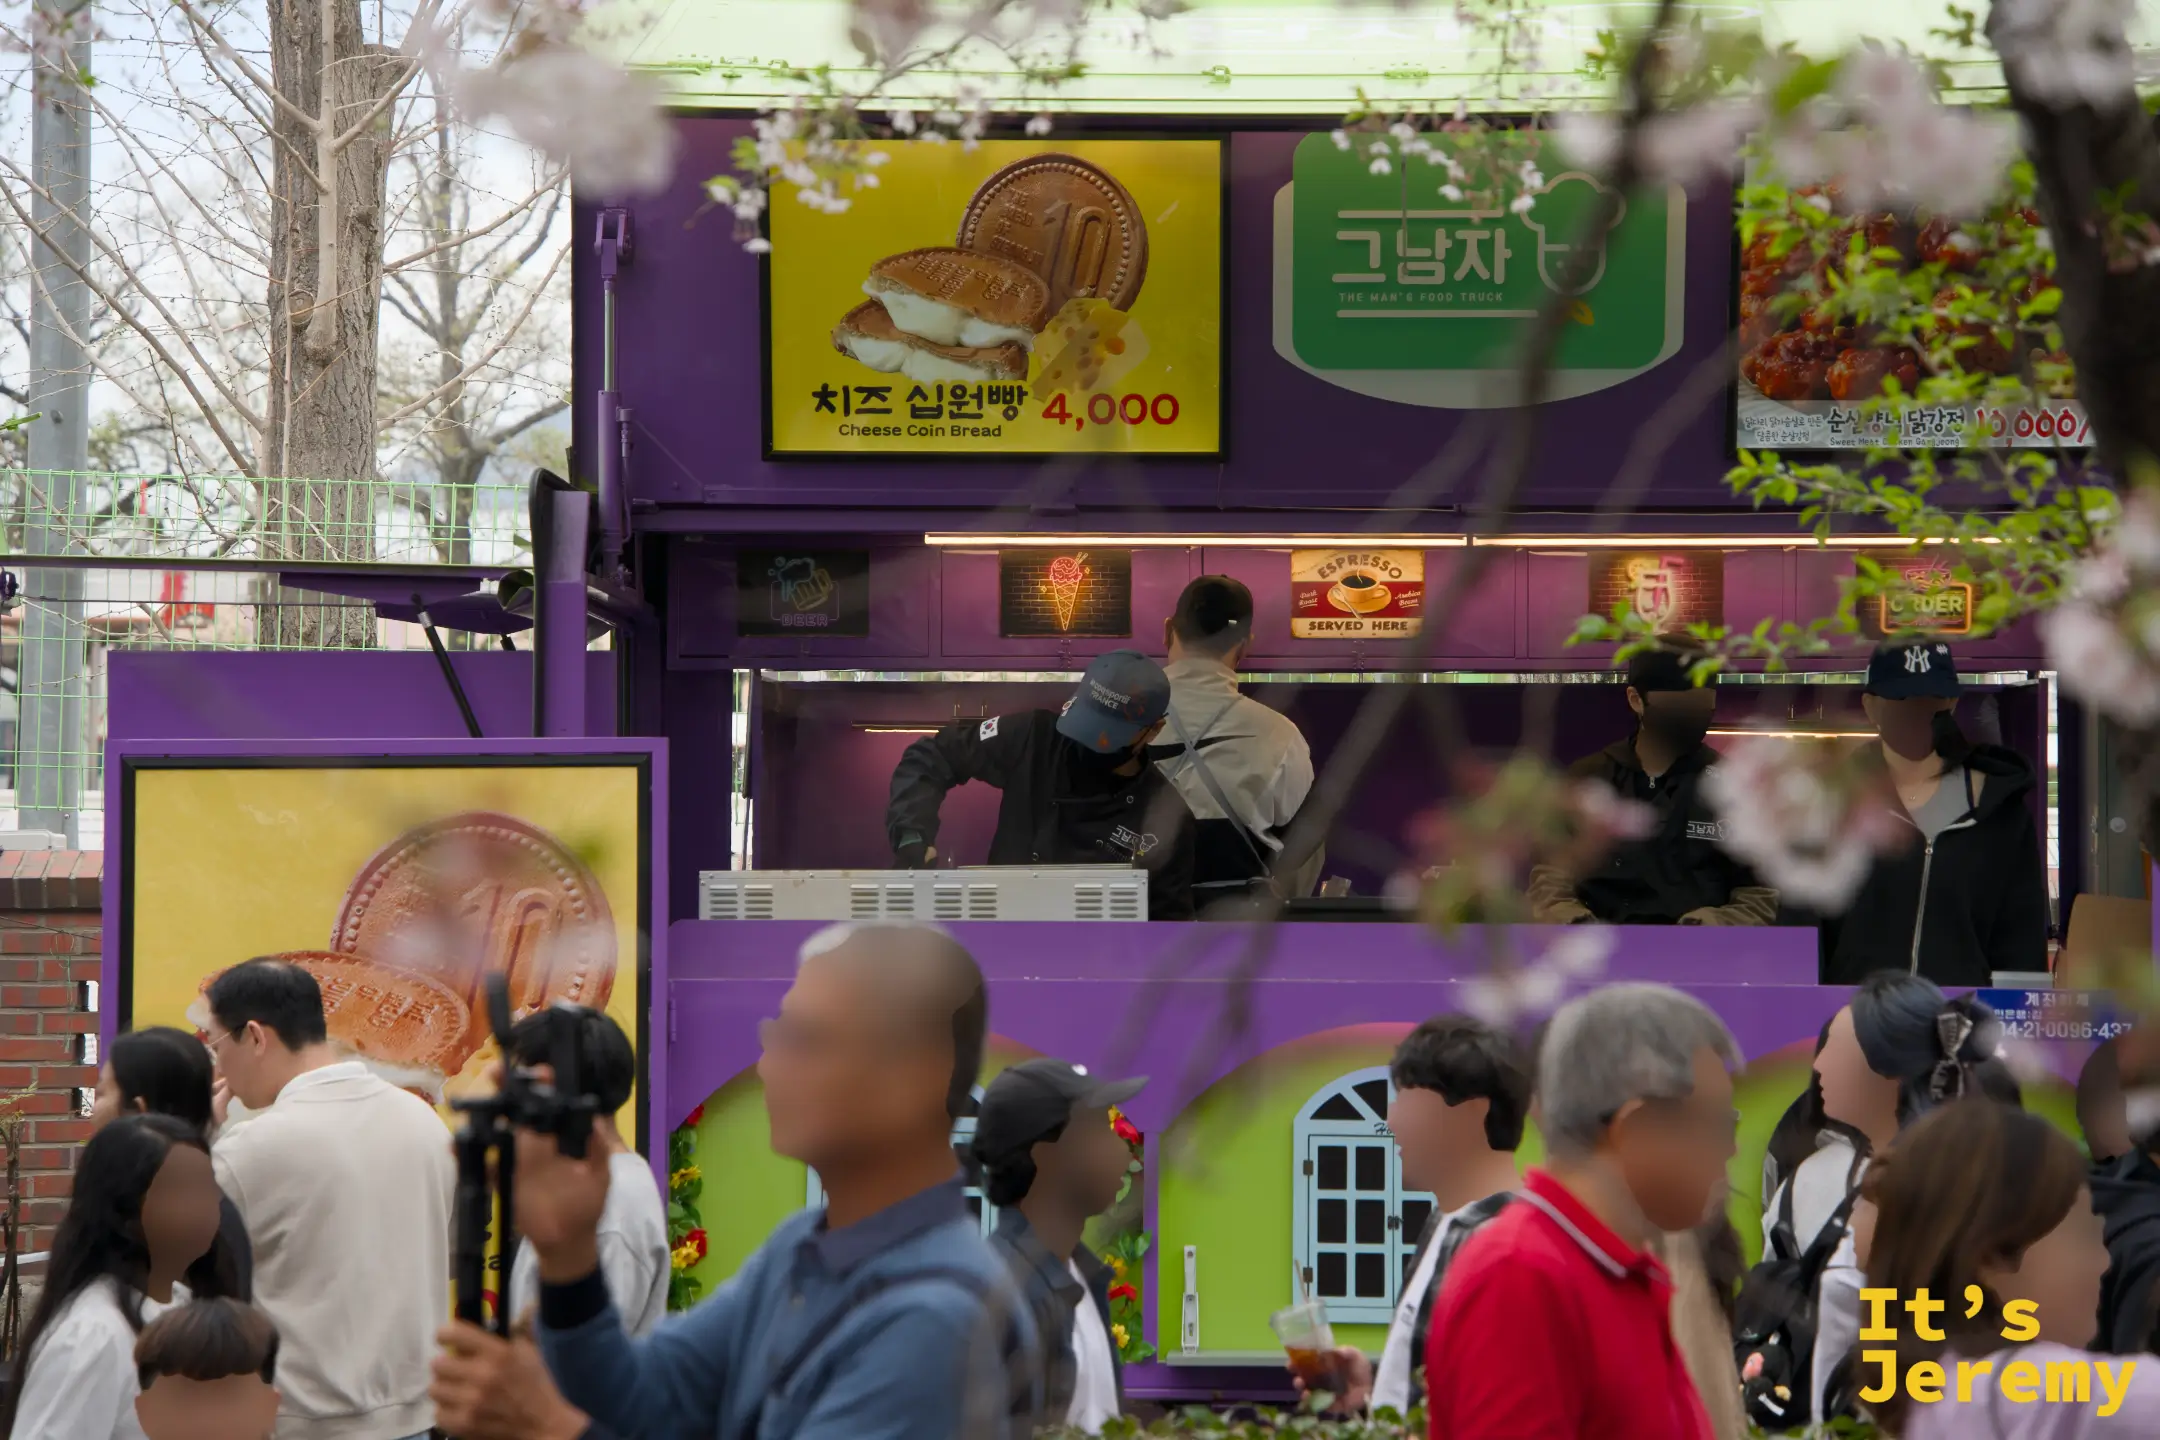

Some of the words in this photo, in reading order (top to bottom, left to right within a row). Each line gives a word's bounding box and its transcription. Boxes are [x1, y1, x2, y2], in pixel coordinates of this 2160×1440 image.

[1331, 227, 1513, 285] 그남자
[1338, 292, 1364, 302] THE
[1420, 292, 1453, 302] FOOD
[1460, 292, 1503, 302] TRUCK
[811, 382, 893, 418] 치즈
[906, 383, 1029, 421] 십원빵
[1041, 393, 1180, 432] 4,000
[1908, 407, 1965, 435] 닭강정
[838, 423, 902, 437] Cheese
[907, 423, 946, 437] Coin
[950, 424, 1002, 437] Bread
[1830, 438, 1856, 446] Sweet
[1882, 438, 1912, 446] Cken
[1317, 554, 1402, 580] ESPRESSO
[781, 613, 828, 627] BEER
[1308, 620, 1364, 631] SERVED
[1371, 620, 1408, 631] HERE
[1091, 689, 1119, 710] FRANCE
[1686, 823, 1716, 836] 그남자
